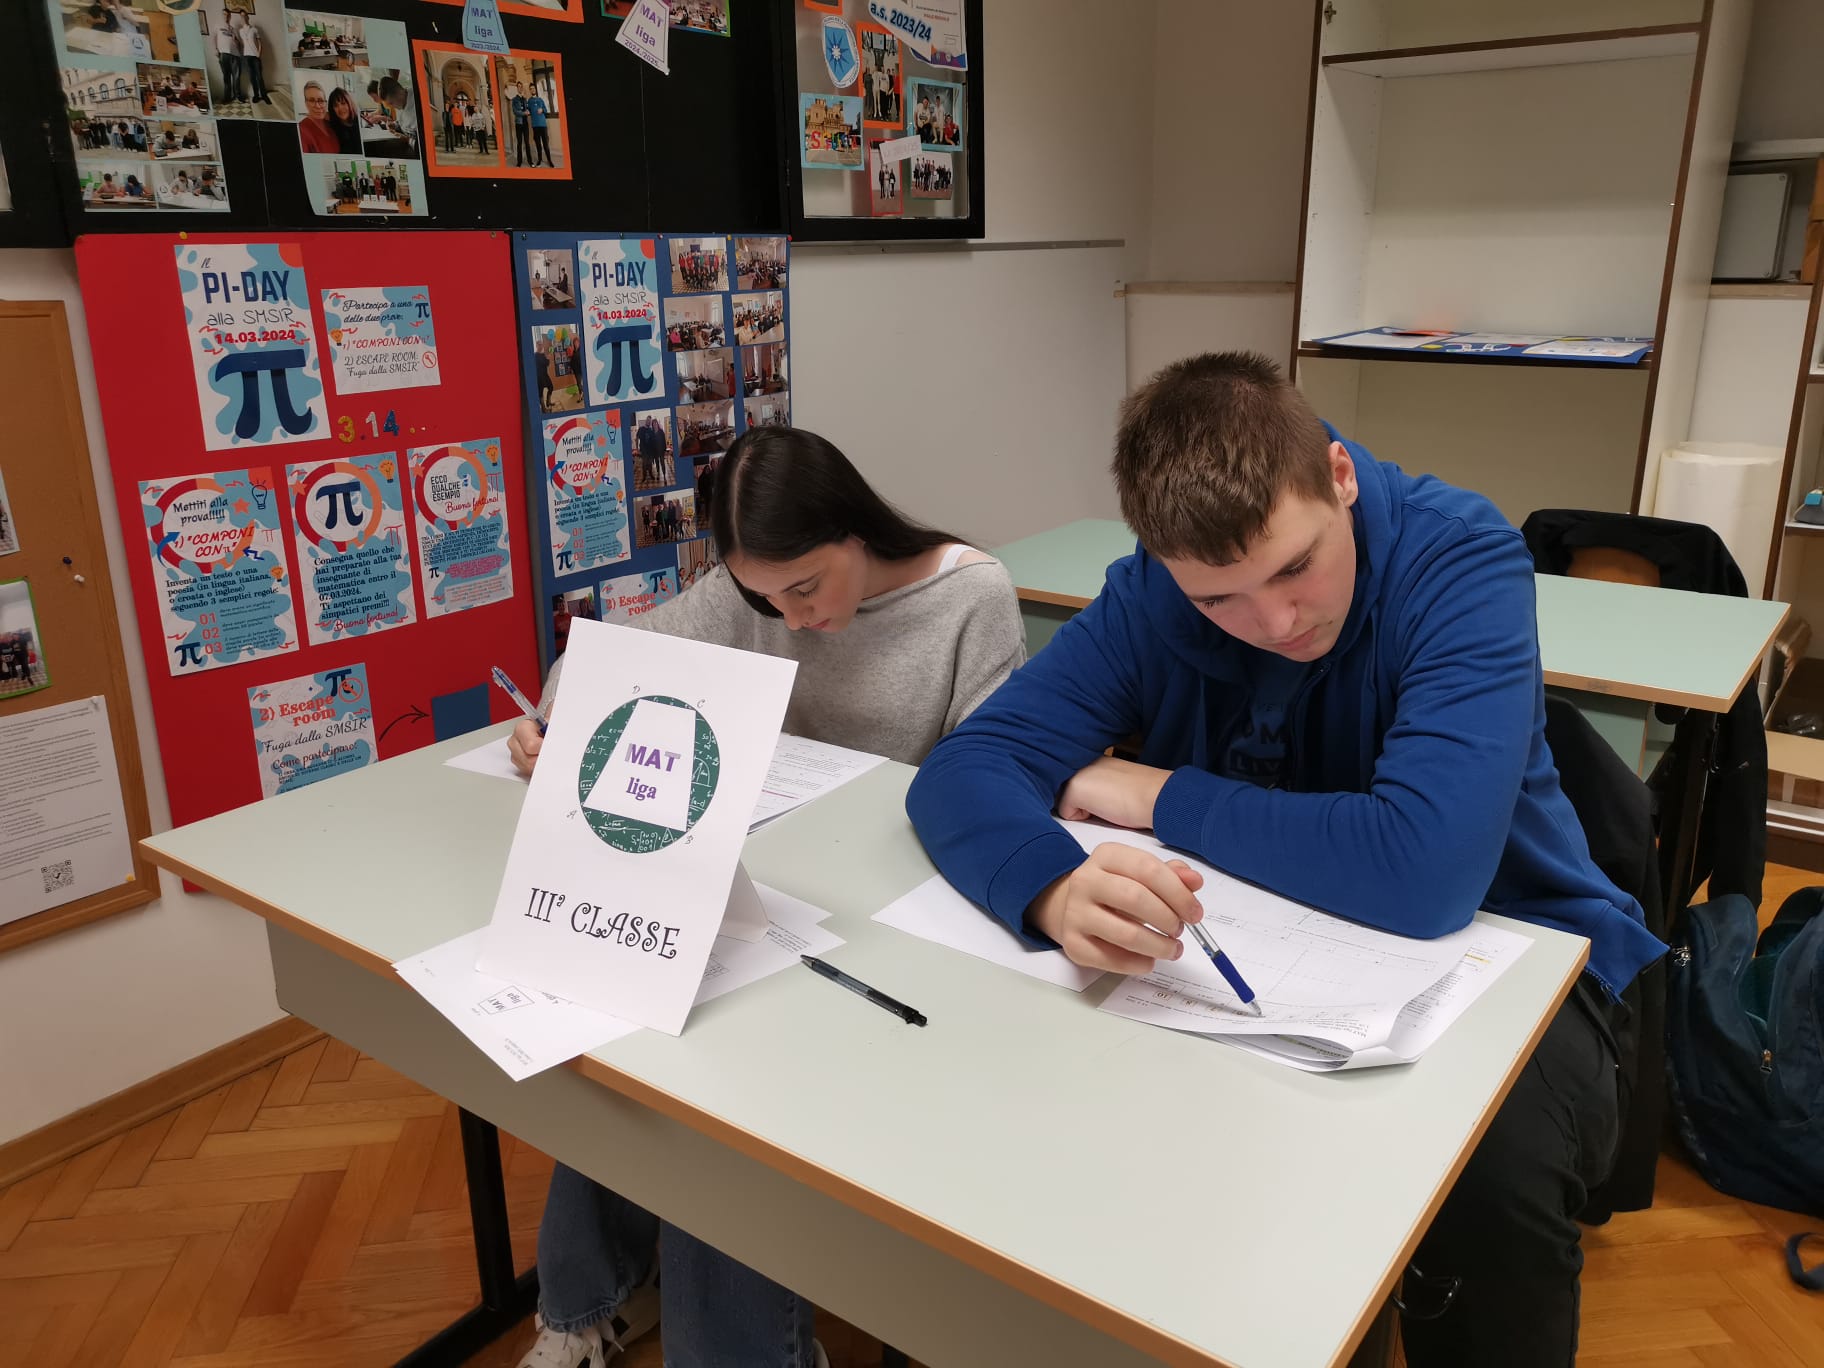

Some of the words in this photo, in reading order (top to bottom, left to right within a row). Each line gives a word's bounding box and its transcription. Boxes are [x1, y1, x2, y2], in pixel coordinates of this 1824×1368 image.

[470, 7, 493, 20] MAT
[640, 4, 664, 28] MAT
[474, 25, 493, 38] liga
[890, 10, 932, 43] 2023/24
[636, 24, 656, 47] liga
[592, 261, 646, 288] PI-DAY
[202, 270, 289, 304] PI-DAY
[343, 300, 388, 312] Partecipa
[593, 295, 610, 306] alla
[614, 292, 647, 304] SMSIR
[207, 311, 234, 326] alla
[243, 308, 296, 324] SMSIR
[344, 314, 364, 323] delle
[365, 313, 380, 322] due
[597, 309, 646, 320] 14.03.2024
[214, 330, 296, 344] 14.03.2024
[356, 353, 389, 366] ESCAPE
[368, 365, 388, 375] dalla
[562, 435, 582, 446] Mettiti
[583, 432, 594, 443] alla
[430, 475, 448, 484] ECCO
[432, 482, 460, 494] QUALCHE
[173, 500, 206, 513] Mettiti
[210, 496, 228, 508] alla
[572, 527, 582, 537] 01
[314, 554, 354, 566] Consegna
[356, 549, 380, 561] quello
[382, 546, 395, 554] che
[315, 566, 328, 576] hai
[332, 560, 371, 574] preparato
[373, 555, 388, 564] alla
[166, 576, 198, 588] Inventa
[243, 567, 258, 576] una
[316, 571, 361, 584] insegnante
[363, 568, 371, 576] di
[318, 580, 366, 594] matematica
[368, 574, 388, 584] entro
[390, 571, 396, 579] il
[168, 585, 194, 598] poesia
[197, 581, 209, 592] (in
[212, 578, 236, 590] lingua
[170, 601, 208, 612] seguendo
[220, 593, 252, 606] semplici
[177, 592, 204, 603] croata
[320, 602, 331, 612] Ti
[334, 596, 372, 610] aspettano
[375, 591, 386, 601] dei
[619, 592, 656, 608] Escape
[322, 606, 360, 620] simpatici
[628, 602, 656, 616] room
[200, 612, 216, 625] 01
[334, 618, 365, 632] Buona
[366, 606, 398, 627] fortuna!
[202, 628, 220, 640] 02
[205, 642, 222, 654] 03
[260, 706, 276, 721] 2)
[280, 695, 334, 717] Escape
[293, 708, 336, 727] room
[295, 730, 322, 746] dalla
[272, 756, 300, 770] Come
[624, 742, 681, 772] MAT
[626, 776, 658, 801] liga
[570, 902, 680, 960] CLASSE
